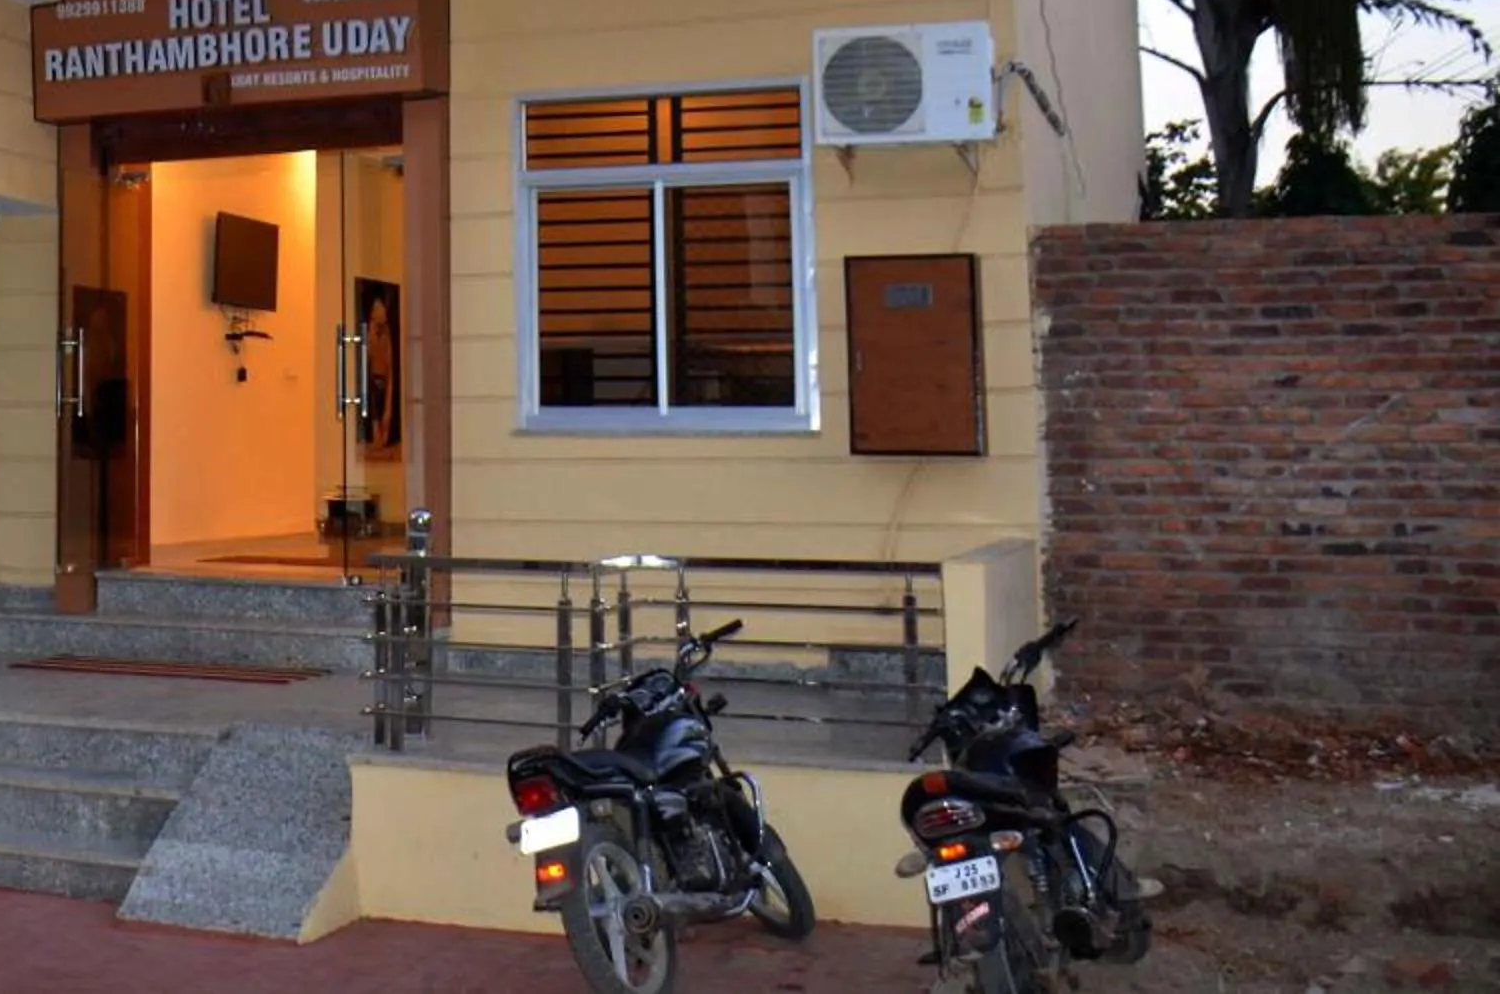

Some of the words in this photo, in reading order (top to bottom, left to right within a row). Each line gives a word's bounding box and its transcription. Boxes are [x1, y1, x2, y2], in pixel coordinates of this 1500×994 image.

[45, 23, 312, 82] RANTHAMBHORE
[322, 16, 414, 58] UDAY
[263, 70, 316, 86] RESORTS
[319, 69, 329, 83] &
[332, 64, 410, 83] HOSPITALITY
